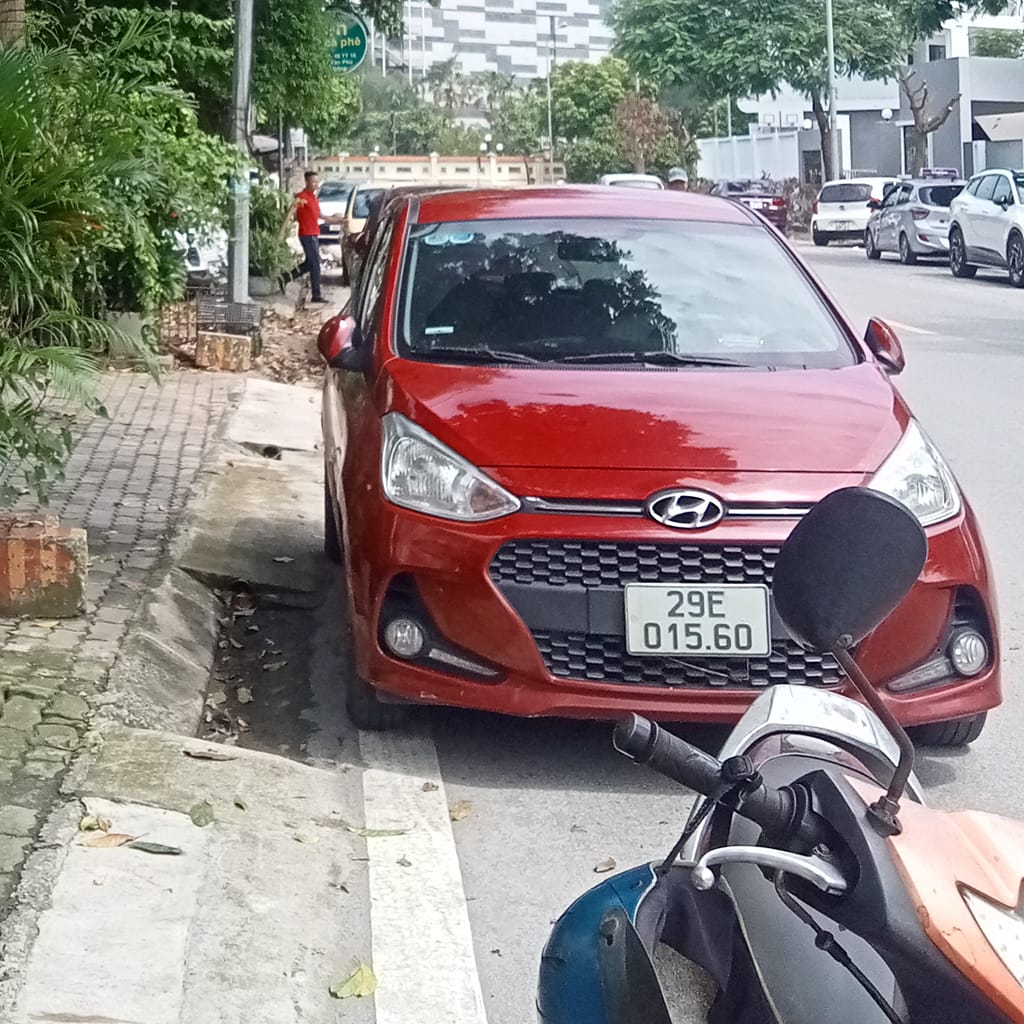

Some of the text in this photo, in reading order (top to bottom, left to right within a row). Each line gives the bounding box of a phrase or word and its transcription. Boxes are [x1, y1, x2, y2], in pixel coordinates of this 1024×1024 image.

[340, 36, 361, 49] phê
[667, 590, 726, 618] 29E
[643, 622, 753, 650] 015.60
